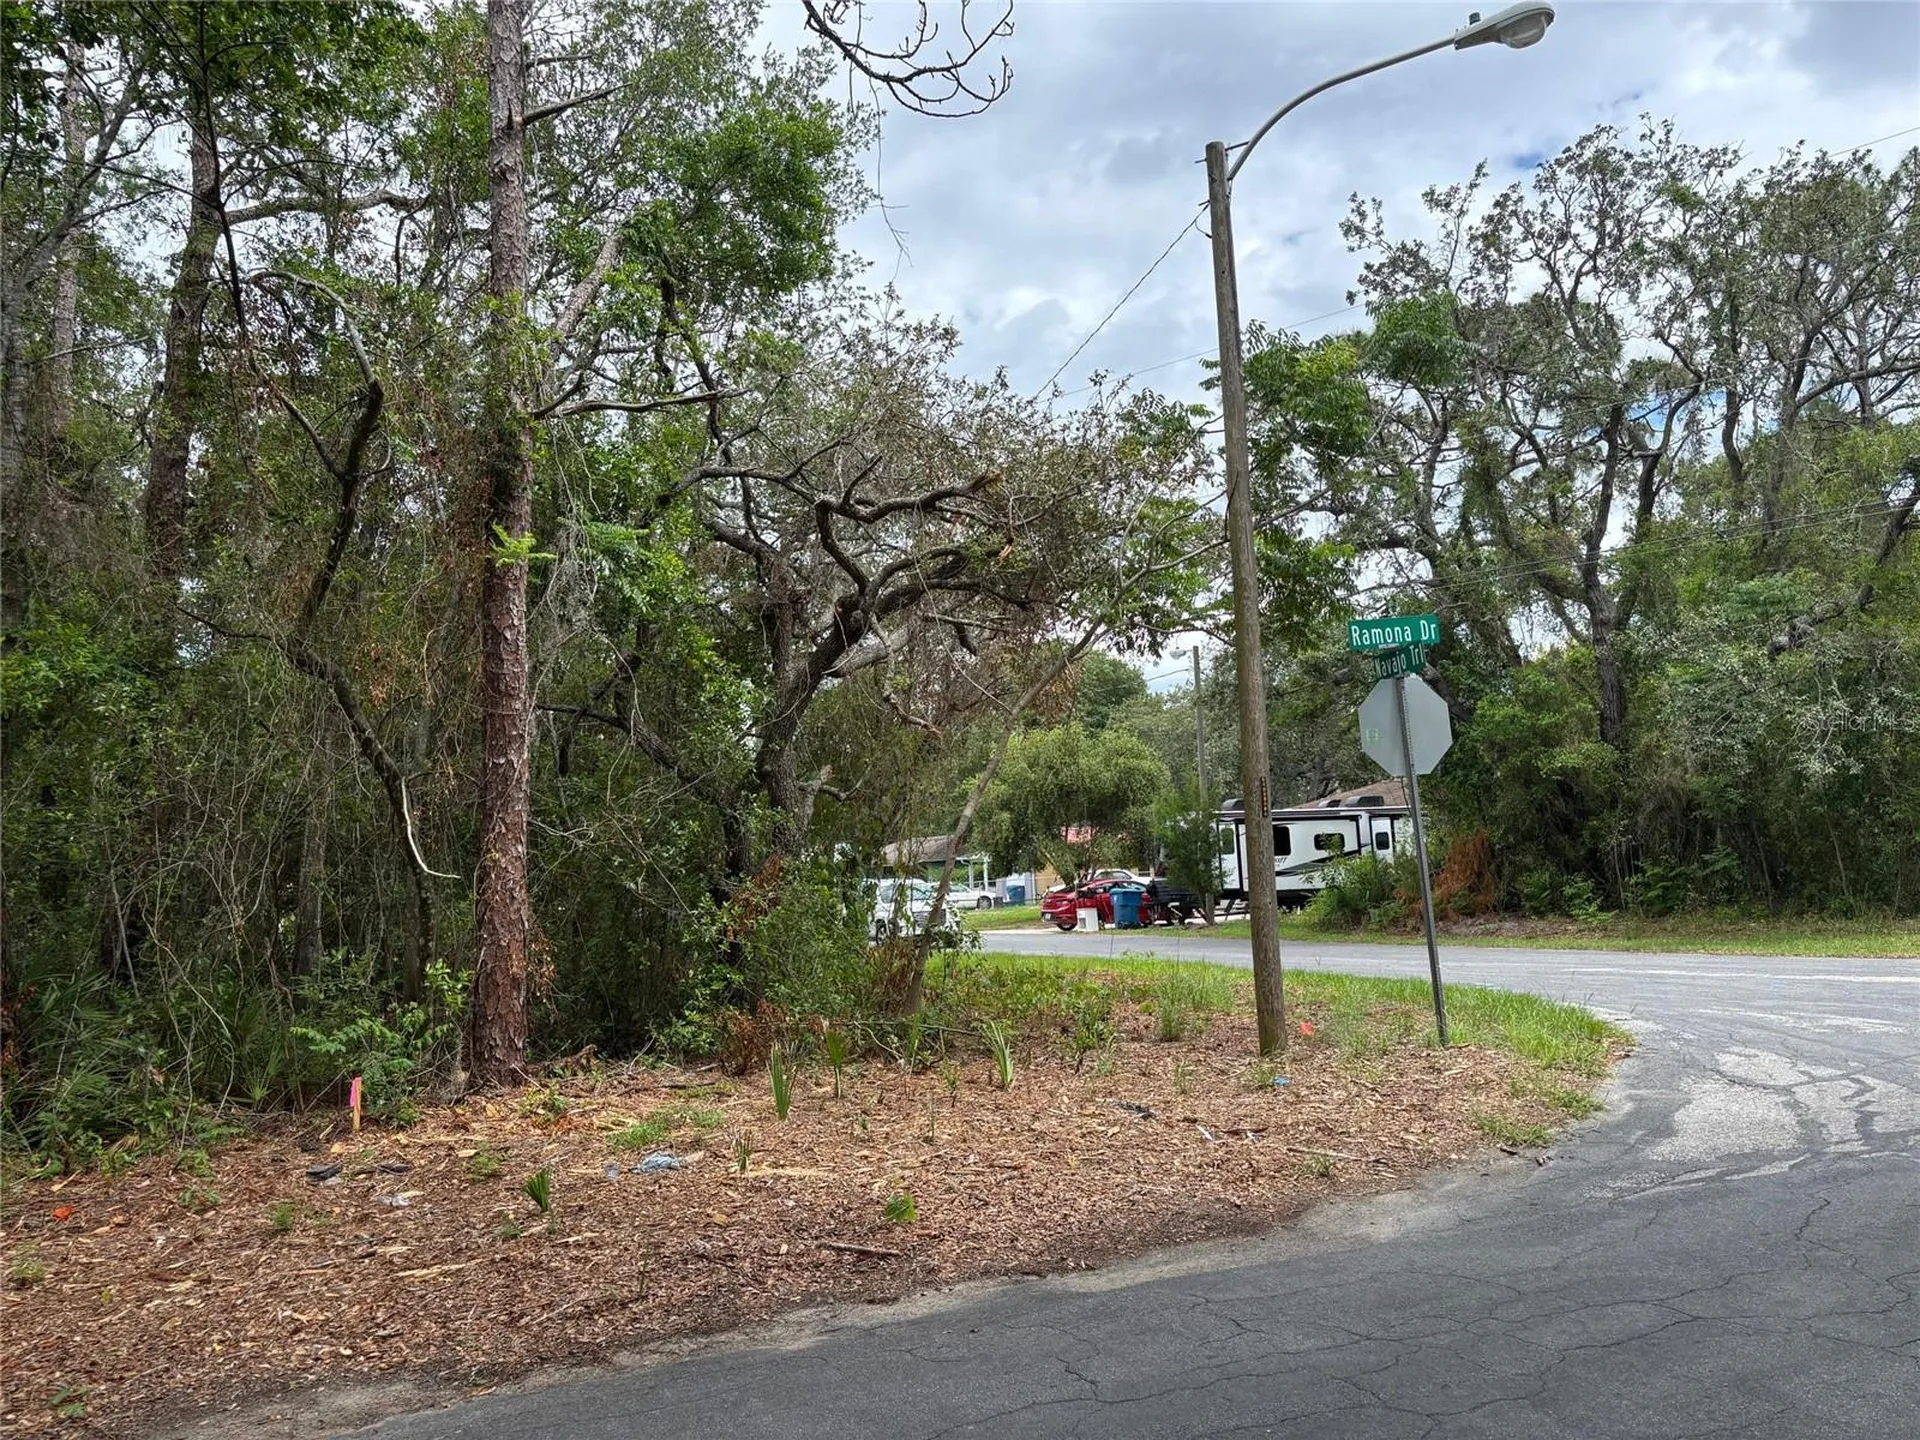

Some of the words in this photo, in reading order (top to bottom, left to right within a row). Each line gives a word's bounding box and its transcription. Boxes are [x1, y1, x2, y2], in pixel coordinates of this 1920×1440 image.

[1351, 625, 1412, 646] Ramona
[1420, 619, 1436, 641] Dr
[1374, 651, 1407, 678] Navajo
[1409, 643, 1424, 666] Trl
